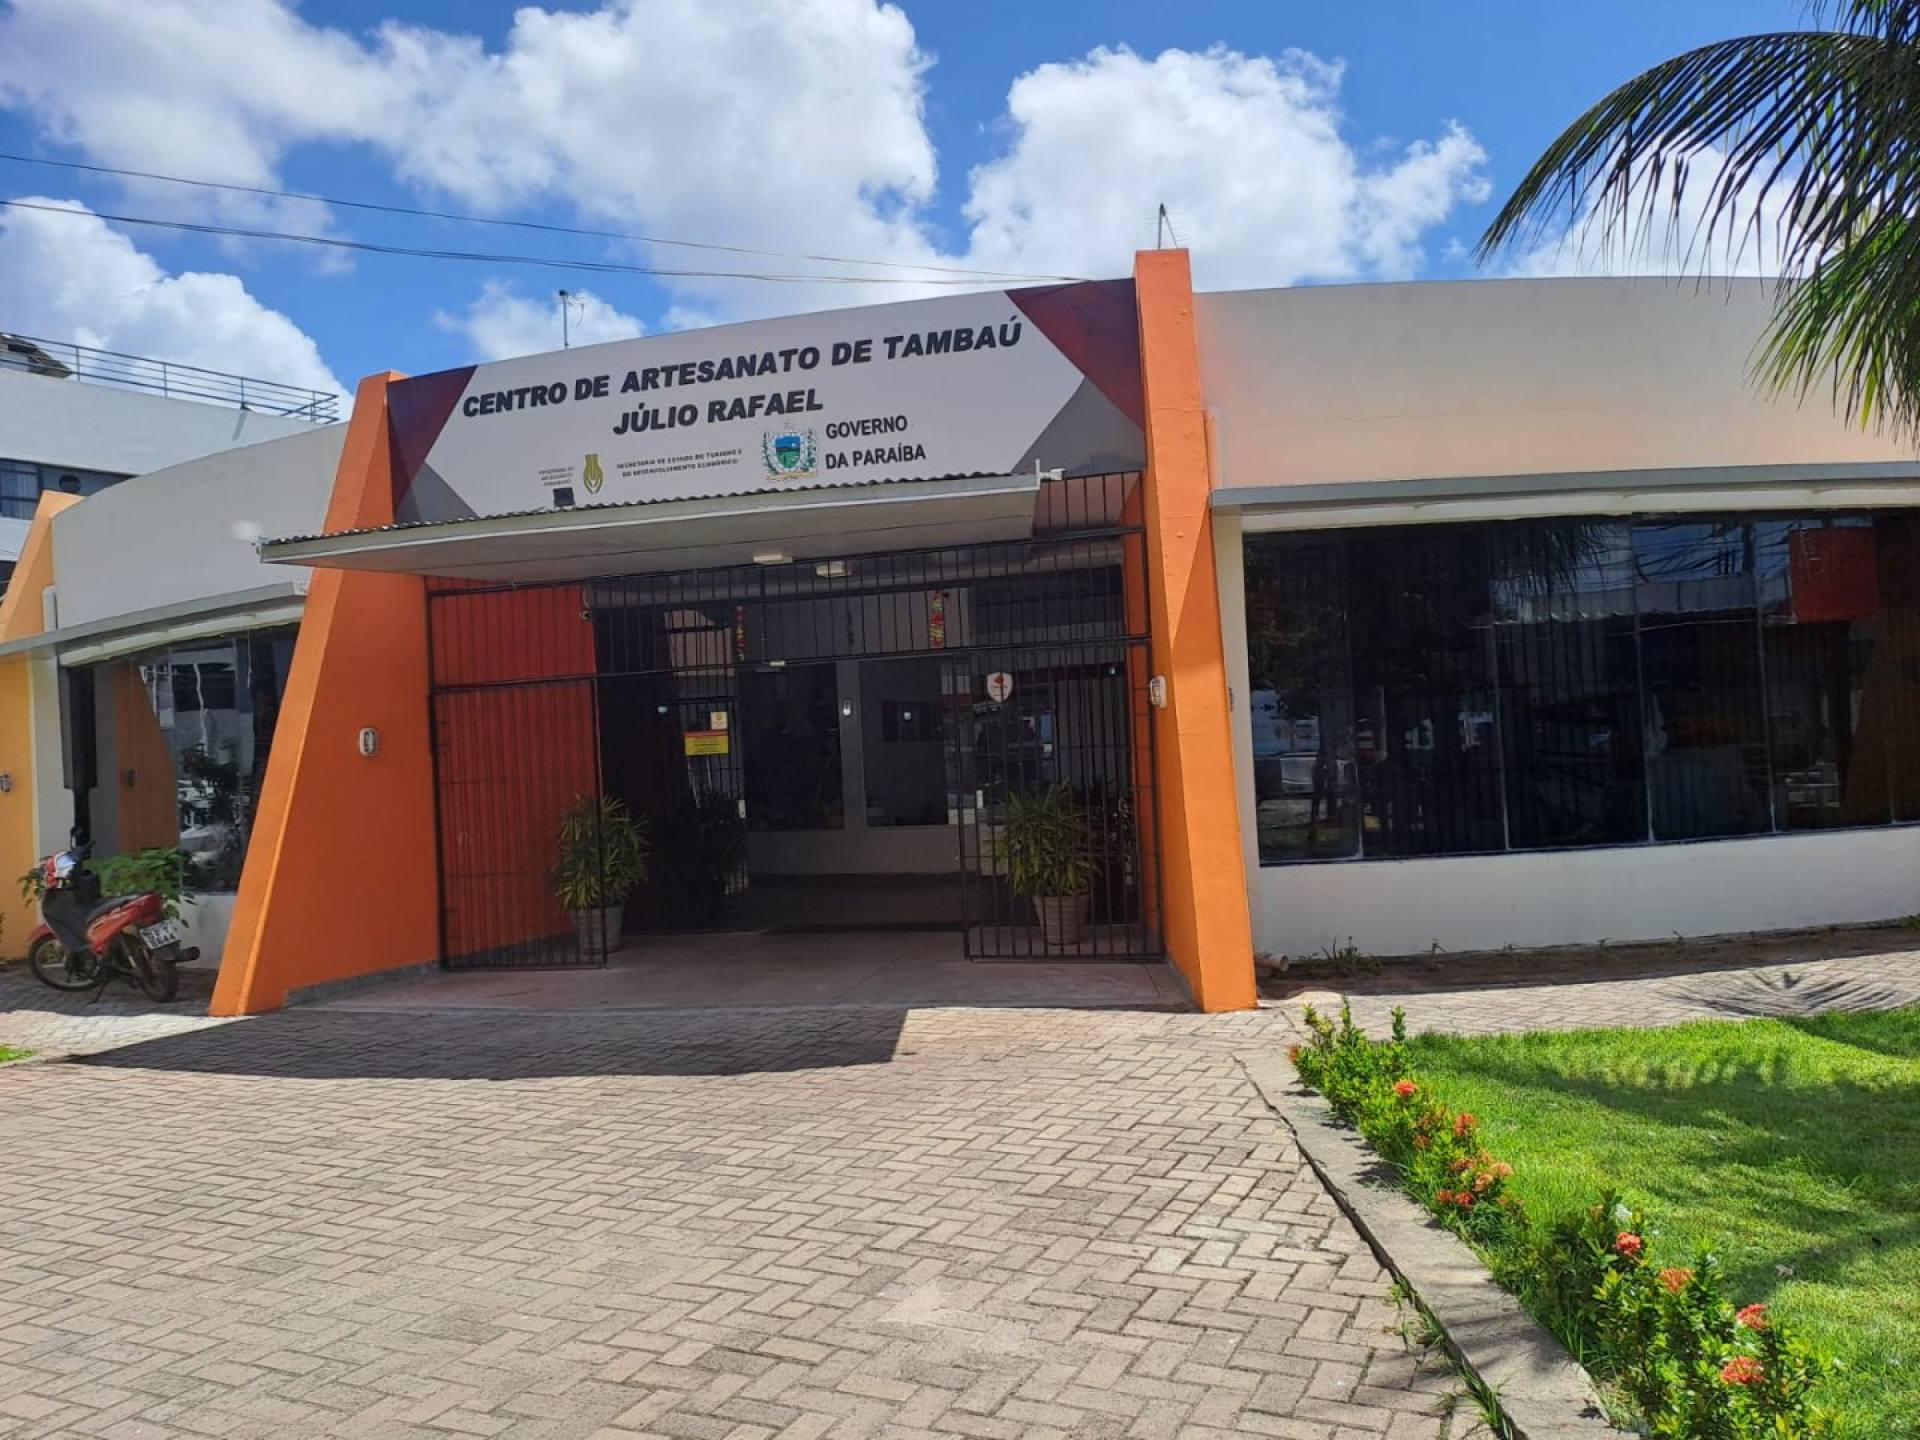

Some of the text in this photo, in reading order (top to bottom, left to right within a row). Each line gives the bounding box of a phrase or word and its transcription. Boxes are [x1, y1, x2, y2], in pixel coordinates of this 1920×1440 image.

[463, 315, 1022, 417] CENTRO DE ARTESANATO DE TAMBAÚ
[613, 389, 823, 435] JÚLIO RAFAEL
[826, 415, 908, 439] GOVERNO
[826, 442, 926, 470] DA PARAÍBA
